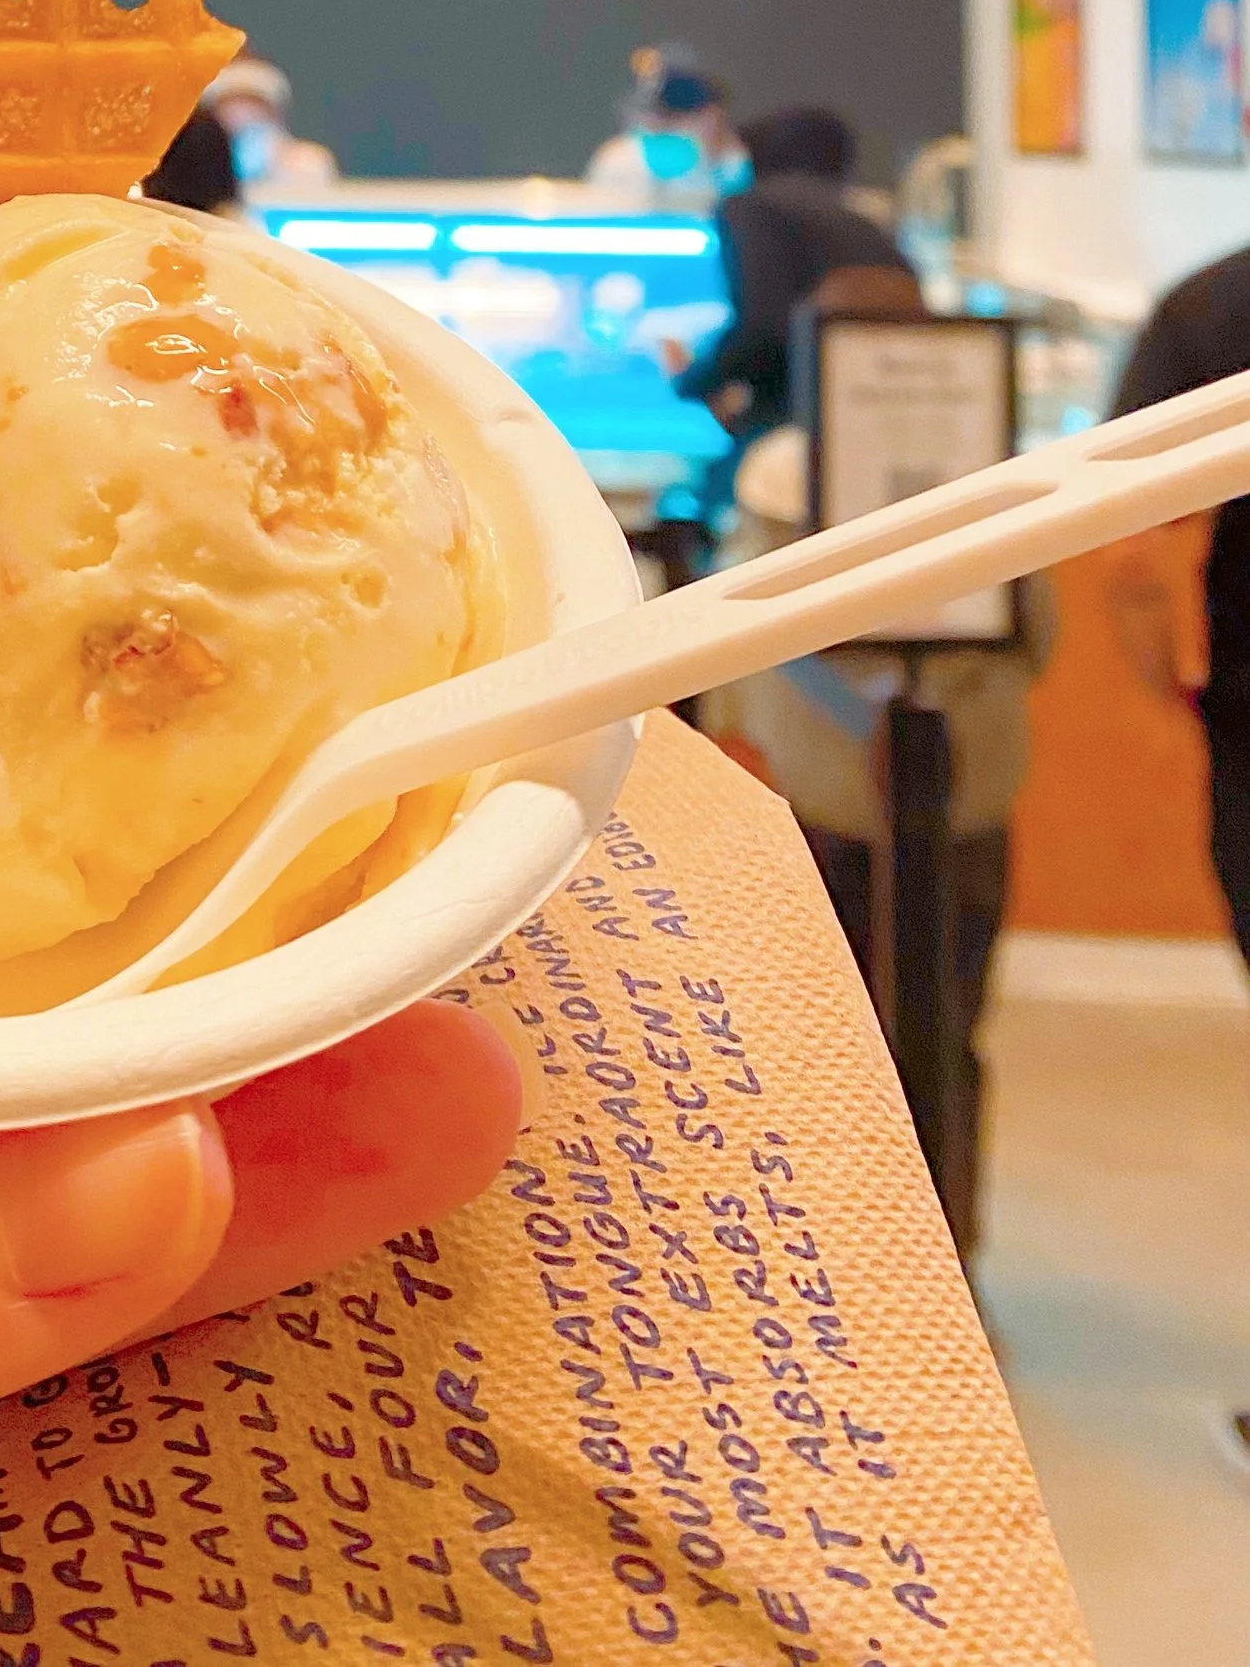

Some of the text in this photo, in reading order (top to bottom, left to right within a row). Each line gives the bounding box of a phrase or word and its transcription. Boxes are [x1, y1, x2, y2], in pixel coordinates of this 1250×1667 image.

[631, 888, 699, 940] AN
[516, 912, 712, 1313] EXTRAORDINAR
[679, 974, 763, 1096] LIKE
[555, 1113, 674, 1391] TONGUE.
[565, 875, 872, 1591] IT ABSORBS SCENT AND
[751, 1131, 859, 1370] MELTS,
[31, 1428, 86, 1481] TO
[78, 1356, 139, 1444] GRO
[339, 1290, 436, 1489] FOUR
[502, 1160, 680, 1645] COMBINATION
[687, 1347, 787, 1540] MOST
[839, 1410, 898, 1479] IT
[103, 1475, 174, 1608] THE
[214, 1360, 328, 1650] SLOWLY
[435, 1341, 554, 1665] LAVOR,
[650, 1440, 741, 1608] YOUR
[880, 1534, 949, 1630] AS
